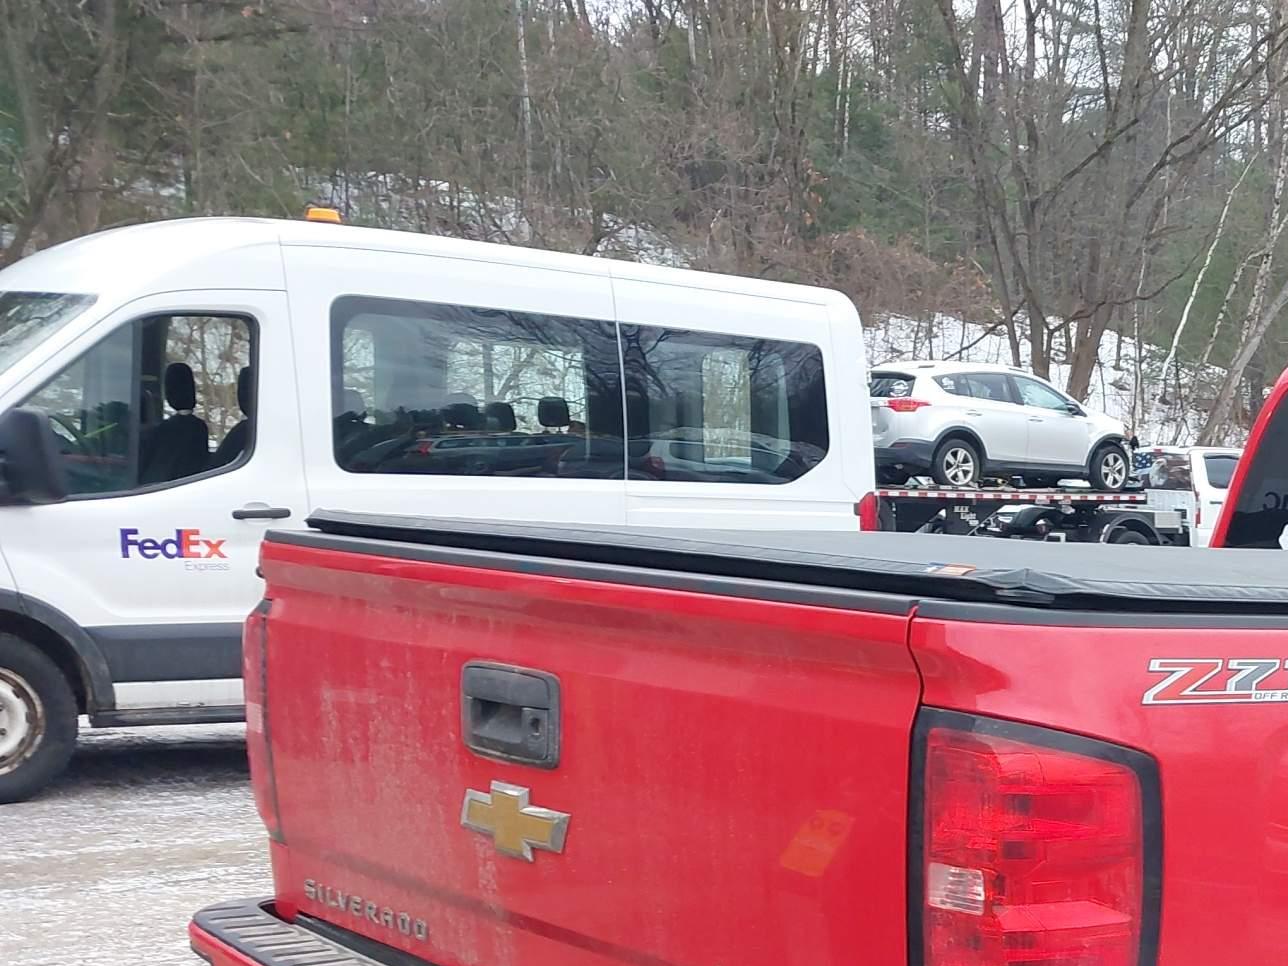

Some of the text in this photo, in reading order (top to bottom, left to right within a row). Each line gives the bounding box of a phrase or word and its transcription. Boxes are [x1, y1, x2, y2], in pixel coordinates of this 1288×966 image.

[120, 528, 227, 559] FedEx
[184, 561, 230, 571] Express
[1254, 692, 1279, 700] OFF
[304, 879, 429, 940] SILVERADO
